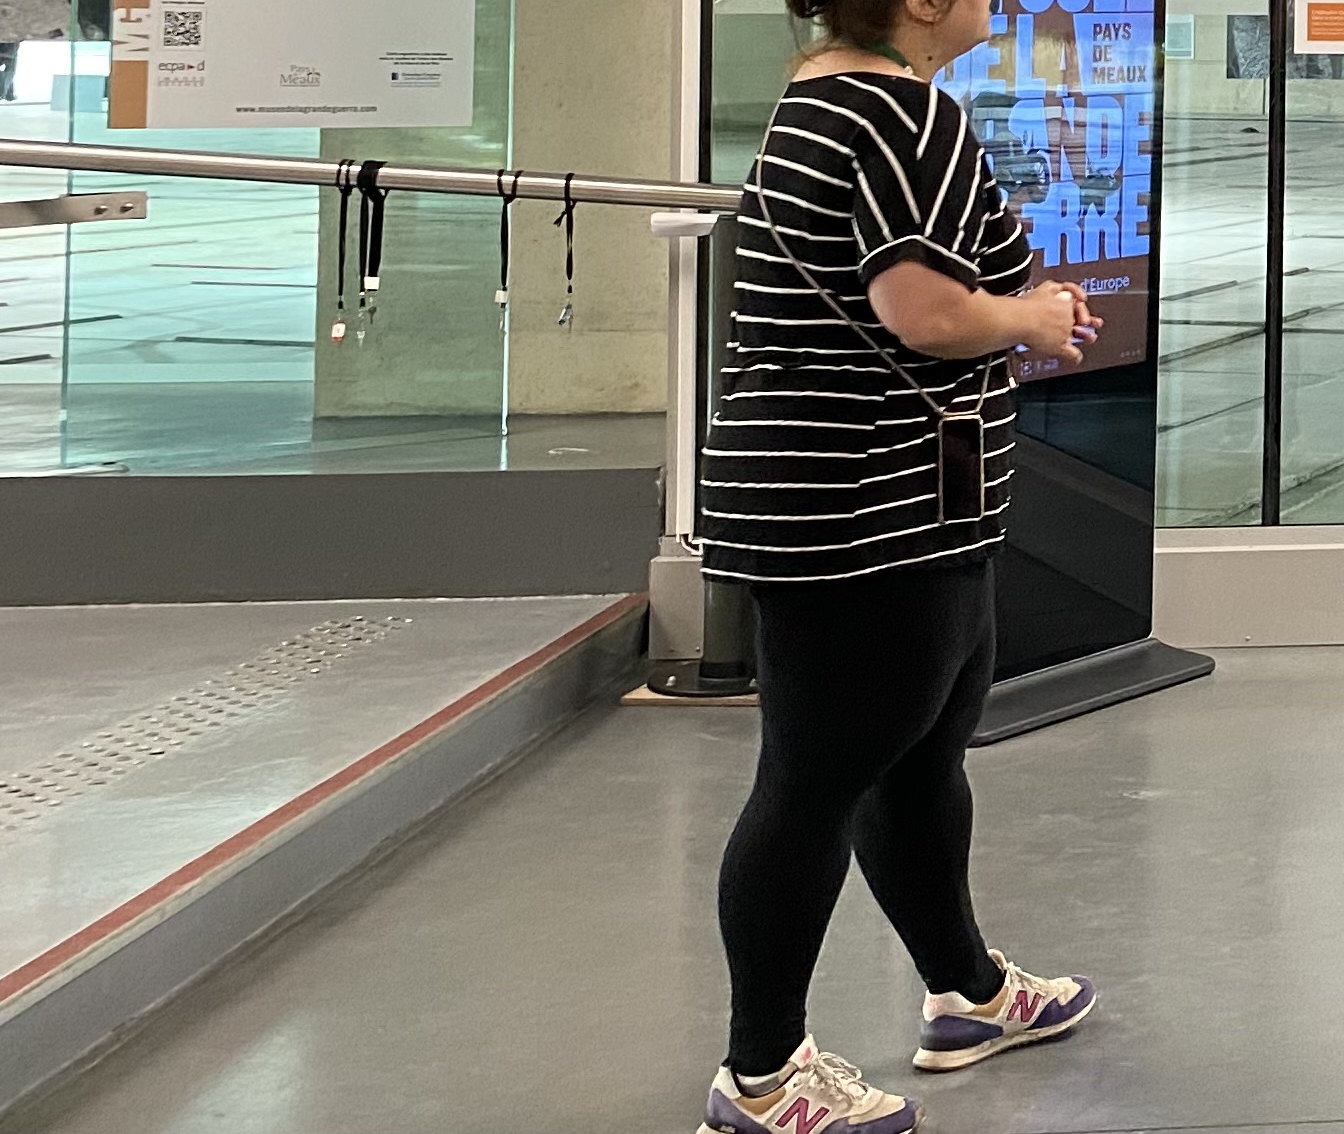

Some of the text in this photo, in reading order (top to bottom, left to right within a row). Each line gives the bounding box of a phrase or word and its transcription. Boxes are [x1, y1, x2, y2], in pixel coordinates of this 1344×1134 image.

[1092, 22, 1132, 41] PAYS
[1092, 45, 1113, 62] DE
[1092, 64, 1147, 85] MEAUX
[1080, 275, 1130, 293] d'Europe
[1006, 989, 1042, 1023] N
[775, 1096, 830, 1134] N
